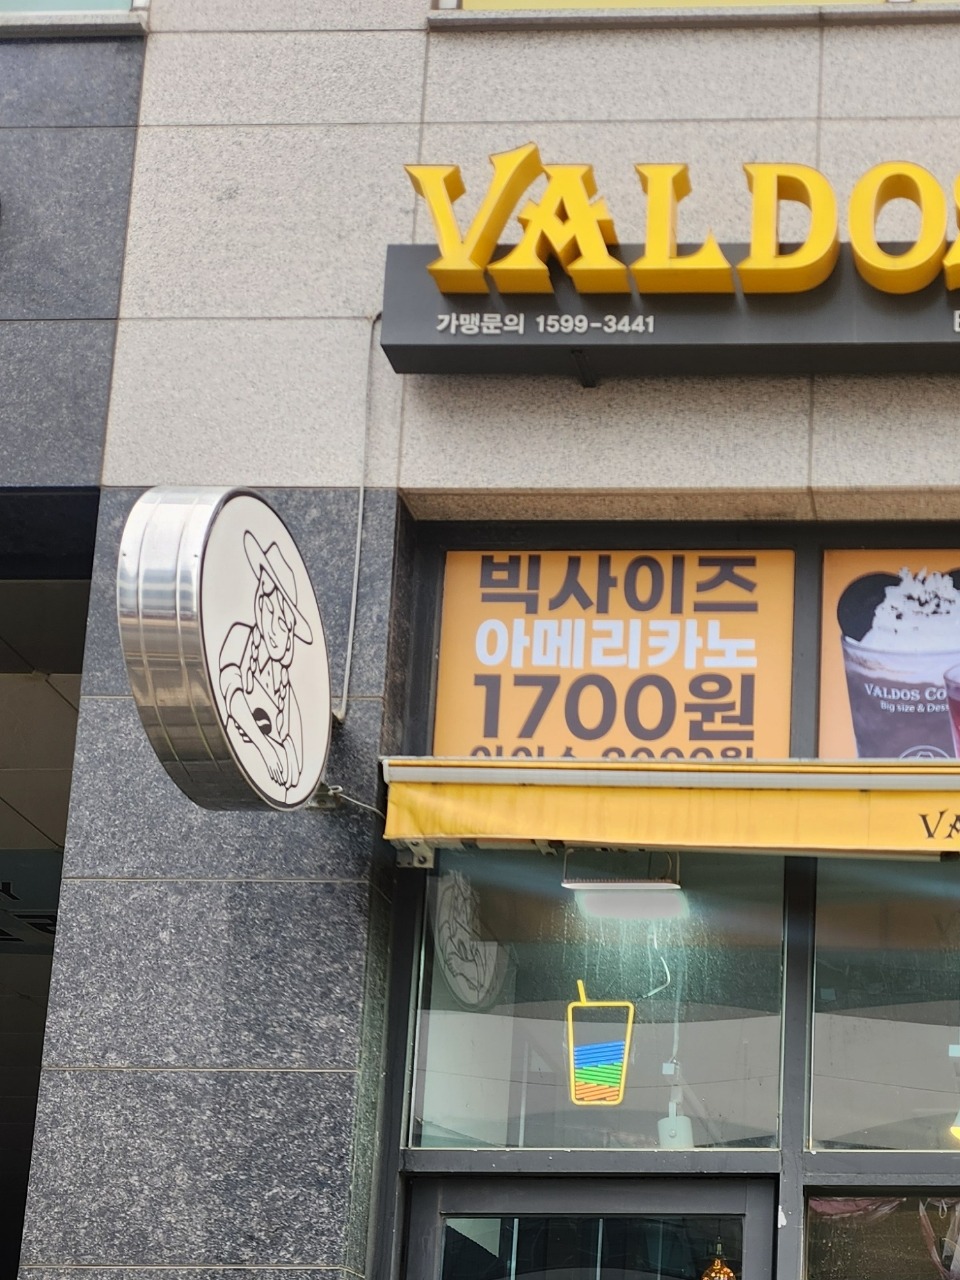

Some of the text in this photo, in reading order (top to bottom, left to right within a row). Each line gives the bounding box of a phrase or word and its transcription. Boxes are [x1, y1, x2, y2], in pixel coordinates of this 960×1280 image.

[436, 312, 655, 336] 가맹문의 1599-3441
[479, 554, 758, 615] 빅사이즈
[475, 618, 758, 670] 아메리카노
[473, 673, 756, 742] 1700원
[864, 683, 921, 701] VALDOS
[880, 701, 950, 713] Big size & Dess
